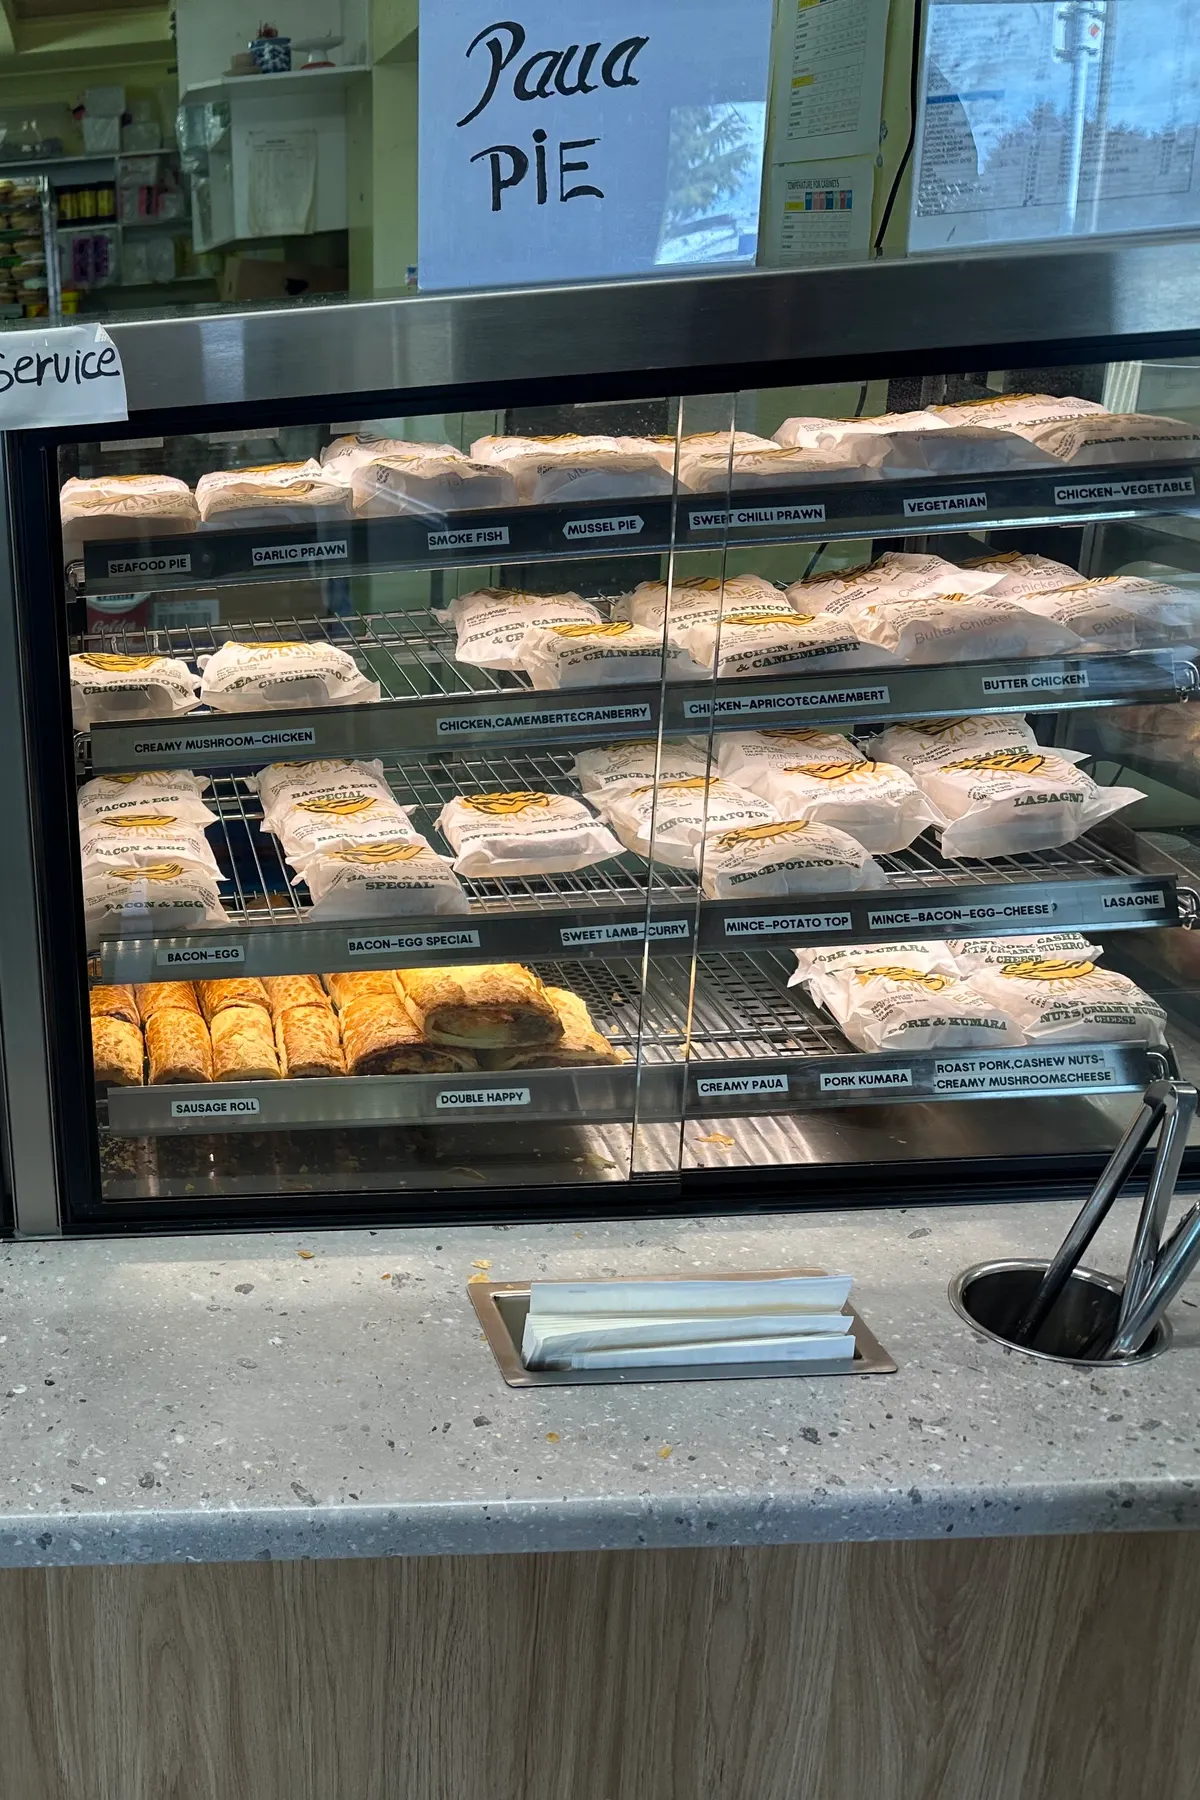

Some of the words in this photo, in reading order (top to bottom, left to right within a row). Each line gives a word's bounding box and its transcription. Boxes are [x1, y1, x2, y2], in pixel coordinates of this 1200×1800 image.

[456, 21, 650, 127] Paua
[1056, 481, 1192, 501] CHICKEN-VEGETABLE
[907, 496, 986, 513] VEGETARIAN
[693, 513, 734, 526] SWEET
[737, 511, 774, 523] CHILLI
[776, 508, 823, 521] PRAWN
[567, 522, 615, 536] MUSSEL
[618, 519, 637, 531] PIE
[428, 533, 473, 546] SMOKE
[476, 531, 503, 543] FISH
[253, 548, 298, 562] GARLIC
[300, 544, 345, 558] PRAWN
[110, 559, 167, 574] SEAFOOD
[169, 558, 187, 570] PIE
[914, 623, 956, 645] Butter
[959, 612, 1015, 631] Chicken
[735, 663, 750, 673] &
[752, 641, 861, 667] CAMEMBERT
[983, 678, 1028, 690] BUTTER
[1031, 673, 1086, 687] CHICKEN
[82, 683, 151, 696] CHICKEN
[134, 741, 182, 754] CREAMY
[185, 731, 313, 750] MUSHROOM-CHICKEN
[94, 800, 141, 814] BACON
[152, 795, 180, 804] EGG
[379, 828, 409, 836] EGG
[415, 874, 450, 882] EGG
[728, 864, 777, 886] MINCE
[776, 858, 834, 871] POTATO
[365, 881, 435, 891] SPECIAL
[158, 900, 170, 908] &
[172, 900, 204, 908] EGG
[1104, 895, 1159, 908] LASAGNE
[726, 917, 822, 932] MINCE-POTATO
[824, 916, 849, 927] TOP
[349, 937, 423, 951] BACON-EGG
[426, 933, 473, 947] SPECIAL
[562, 930, 602, 943] SWEET
[167, 948, 240, 963] BACON-EGG
[984, 955, 994, 964] &
[996, 954, 1042, 964] CHEESE
[933, 1017, 947, 1027] &
[948, 1017, 1008, 1031] KUMARA
[1093, 1015, 1137, 1025] CHEESE
[936, 1060, 976, 1074] ROAST
[700, 1080, 749, 1093] CREAMY
[752, 1078, 784, 1090] PAUA
[824, 1075, 856, 1087] PORK
[858, 1072, 909, 1085] KUMARA
[440, 1091, 485, 1105] DOUBLE
[487, 1089, 524, 1103] HAPPY
[176, 1101, 226, 1114] SAUSAGE
[228, 1100, 257, 1112] ROLL
